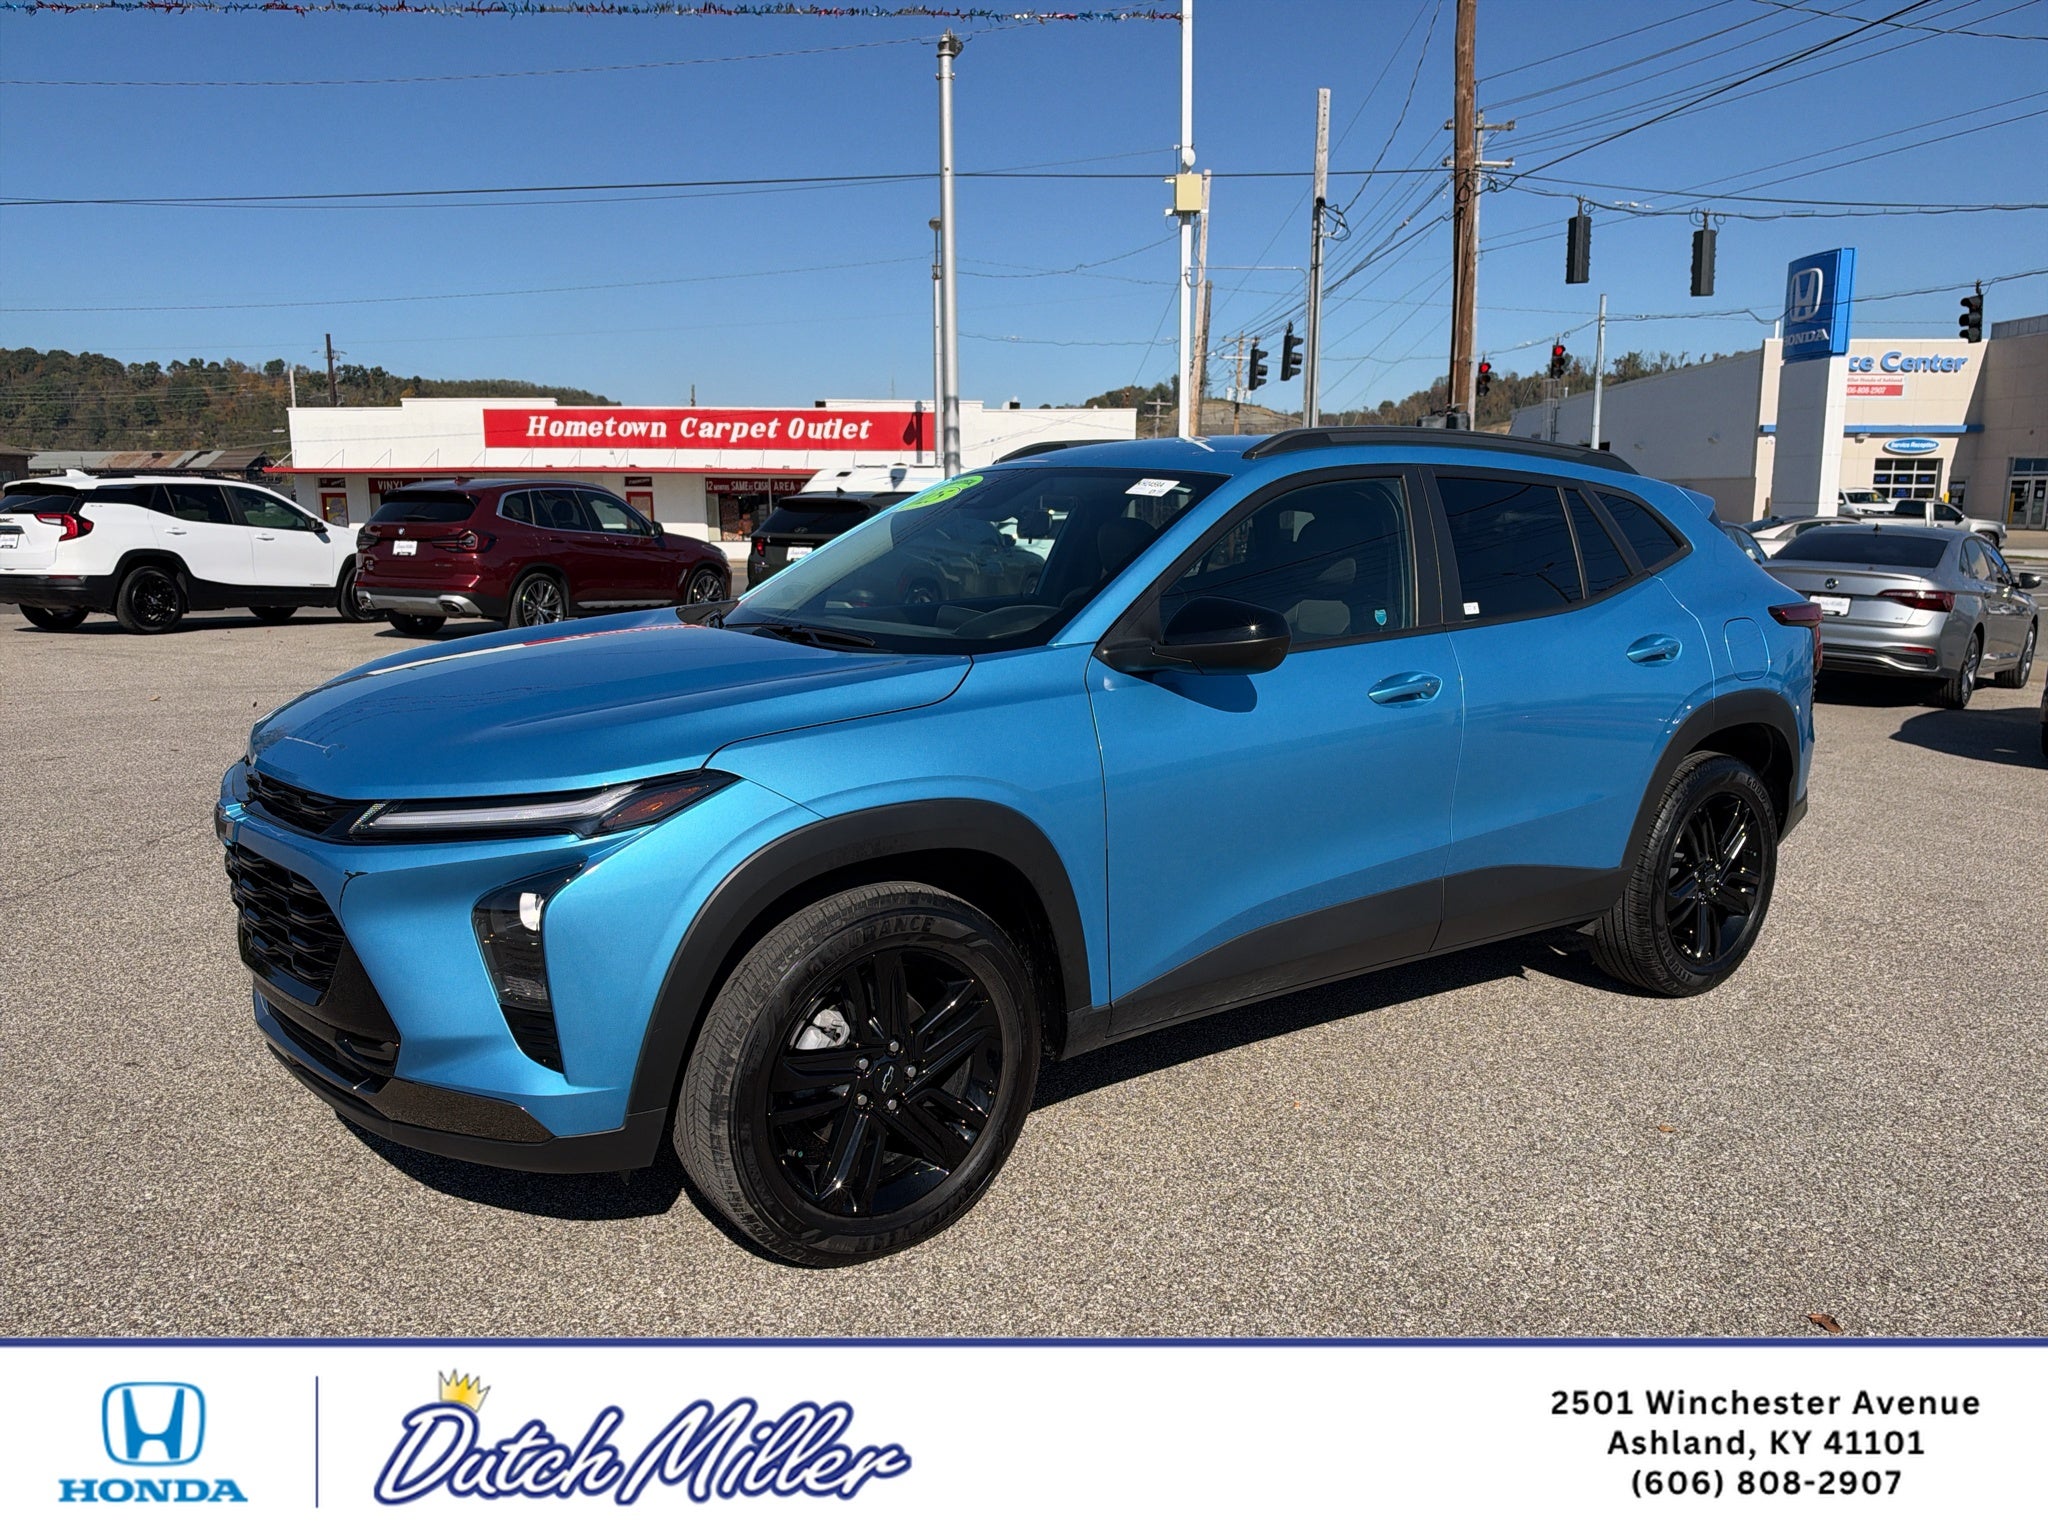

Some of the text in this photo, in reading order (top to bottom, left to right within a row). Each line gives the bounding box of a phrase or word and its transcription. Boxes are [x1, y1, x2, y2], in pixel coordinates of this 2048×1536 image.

[1784, 328, 1830, 346] HONDA
[1880, 351, 1968, 372] Center
[526, 415, 873, 443] Hometown Carpet Outlet
[706, 481, 714, 490] 12
[731, 481, 748, 491] SAME
[753, 481, 770, 491] CASH
[773, 481, 796, 491] AREA
